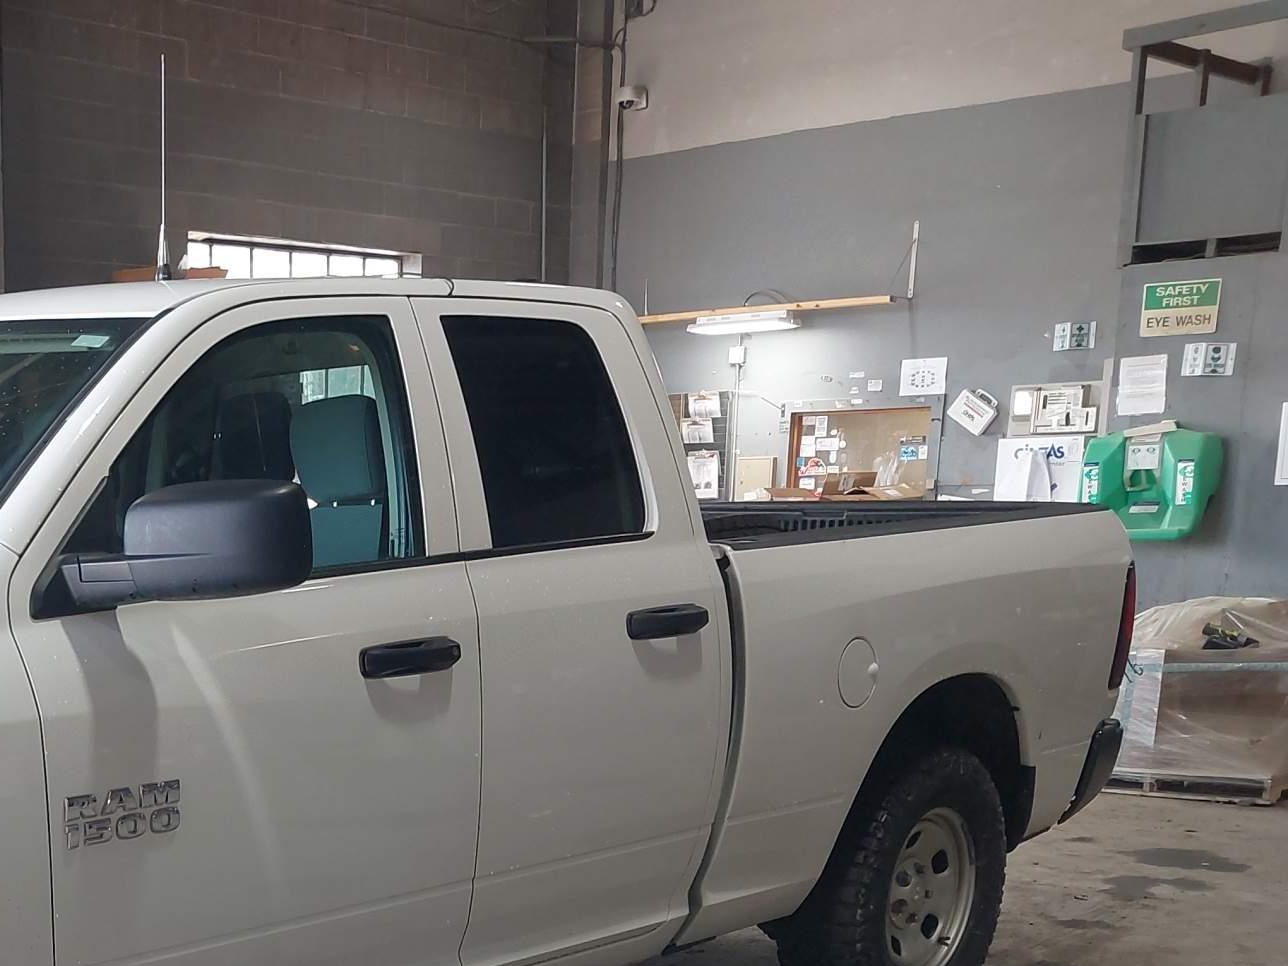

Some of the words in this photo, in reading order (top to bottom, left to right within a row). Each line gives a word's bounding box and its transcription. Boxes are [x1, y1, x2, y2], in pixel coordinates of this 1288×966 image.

[1156, 283, 1209, 297] SAFETY
[1162, 296, 1200, 307] FIRST
[1146, 317, 1170, 328] EYE
[1176, 314, 1212, 327] WASH
[64, 779, 181, 822] RAM
[65, 806, 181, 849] 1500
